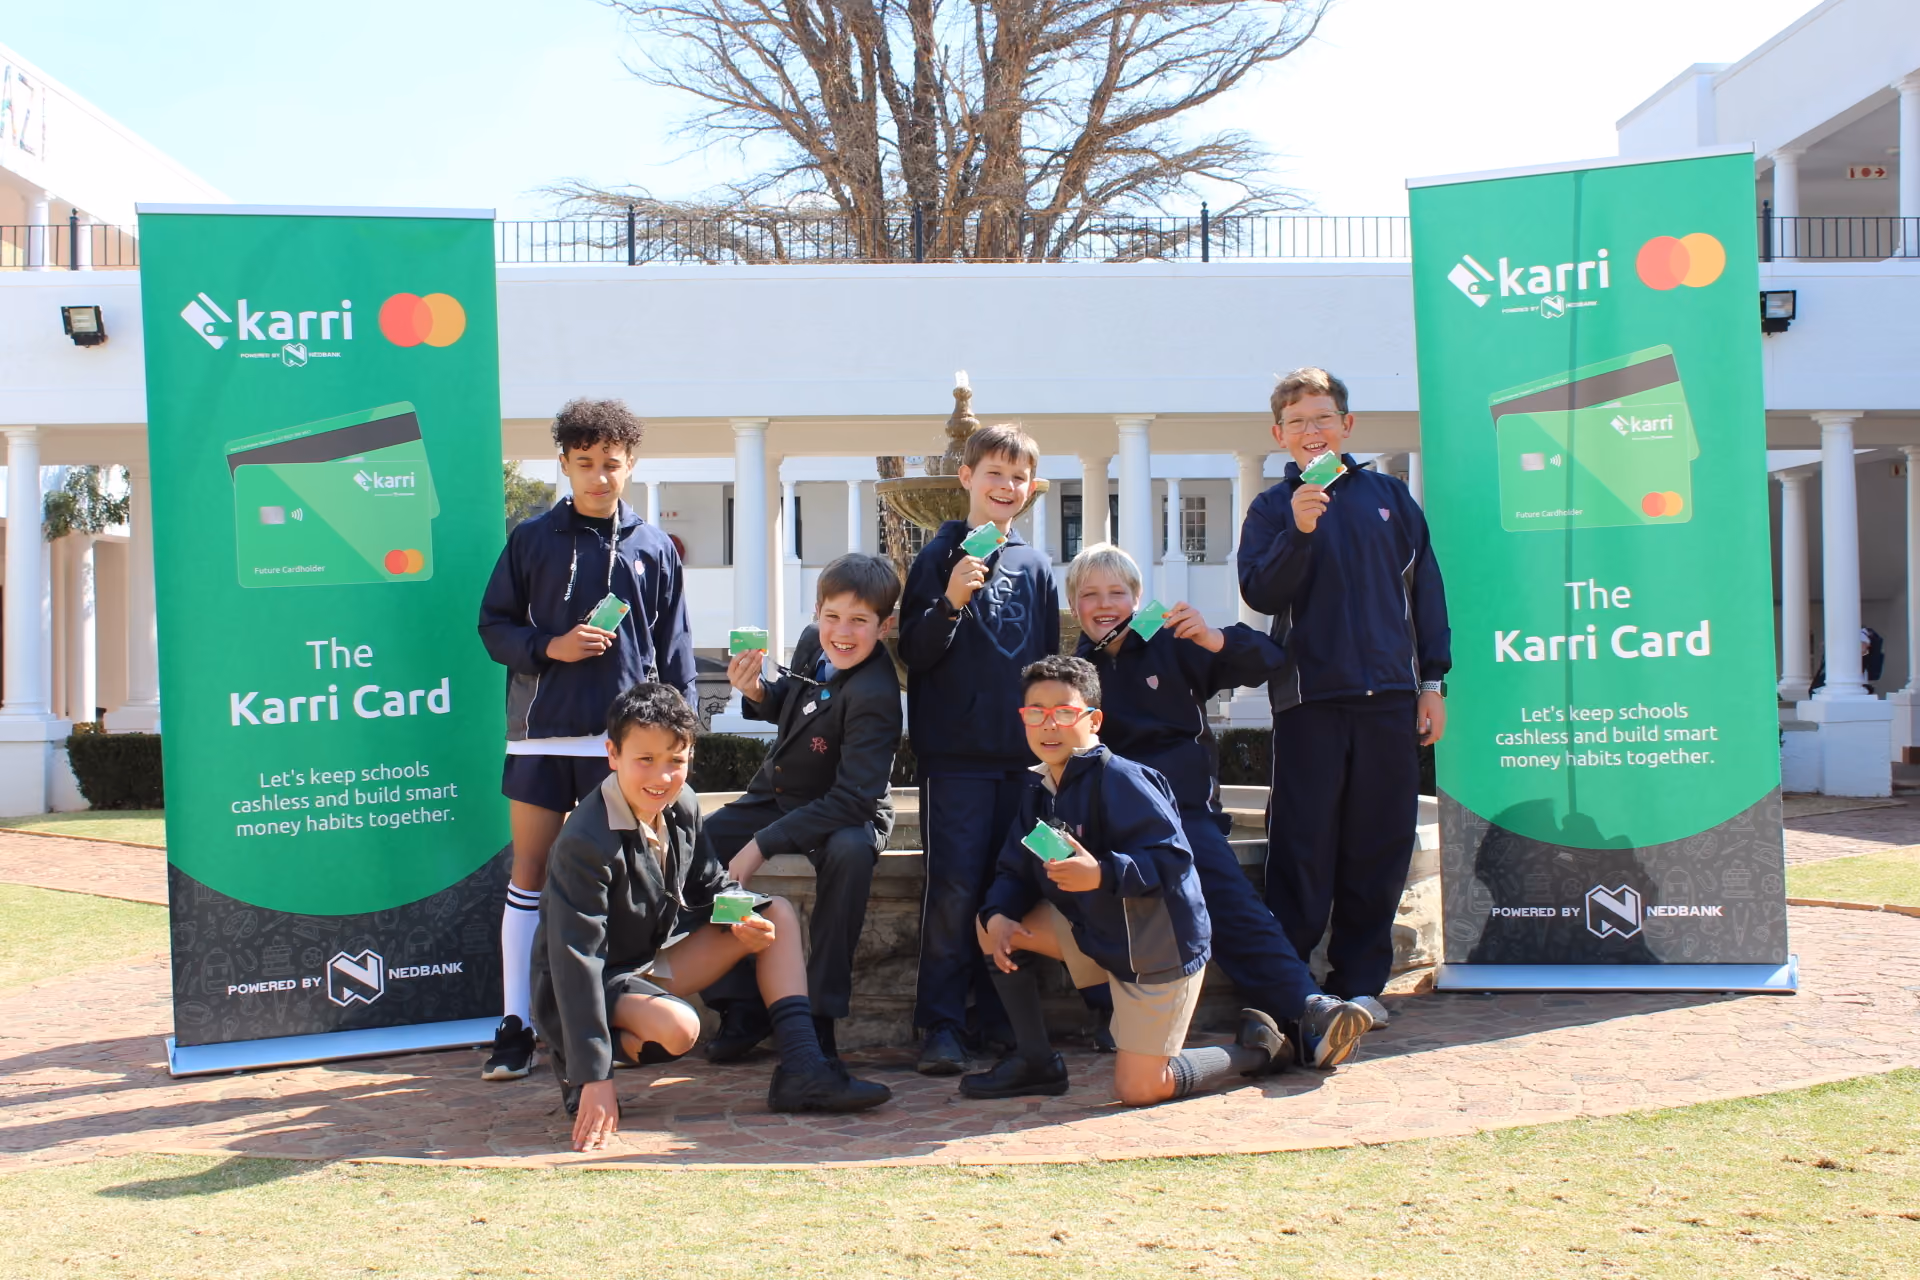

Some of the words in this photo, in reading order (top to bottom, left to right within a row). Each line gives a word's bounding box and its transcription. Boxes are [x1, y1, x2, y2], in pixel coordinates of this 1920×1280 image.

[1499, 248, 1609, 297] karri
[238, 299, 352, 340] karri
[1630, 414, 1673, 433] karri
[374, 471, 415, 489] karri
[1515, 511, 1540, 519] Future
[1541, 508, 1584, 517] Cardholder
[254, 567, 281, 575] Future
[282, 564, 326, 574] Cardholder
[1565, 578, 1631, 609] The
[306, 637, 372, 669] The
[1495, 624, 1597, 662] Karri
[1611, 620, 1711, 658] Card
[230, 684, 338, 726] Karri
[353, 677, 450, 718] Card
[1522, 706, 1564, 722] Let's
[1570, 706, 1614, 723] keep
[1620, 702, 1688, 719] schools
[1496, 729, 1568, 745] cashless
[1574, 727, 1608, 744] and
[1613, 725, 1659, 742] build
[1665, 726, 1718, 741] smart
[1501, 755, 1560, 770] money
[1566, 750, 1621, 766] habits
[1627, 748, 1714, 768] together.
[261, 770, 304, 788] Let's
[311, 768, 355, 785] keep
[362, 761, 429, 781] schools
[232, 794, 309, 813] cashless
[315, 790, 348, 807] and
[355, 786, 400, 804] build
[406, 783, 458, 801] smart
[237, 821, 300, 836] money
[307, 813, 363, 831] habits
[370, 807, 454, 828] together.
[1492, 908, 1556, 917] POWERED
[1562, 908, 1580, 916] BY
[1648, 906, 1723, 916] NEDBANK
[228, 980, 296, 995] POWERED
[302, 977, 321, 988] BY
[389, 962, 462, 979] NEDBANK
